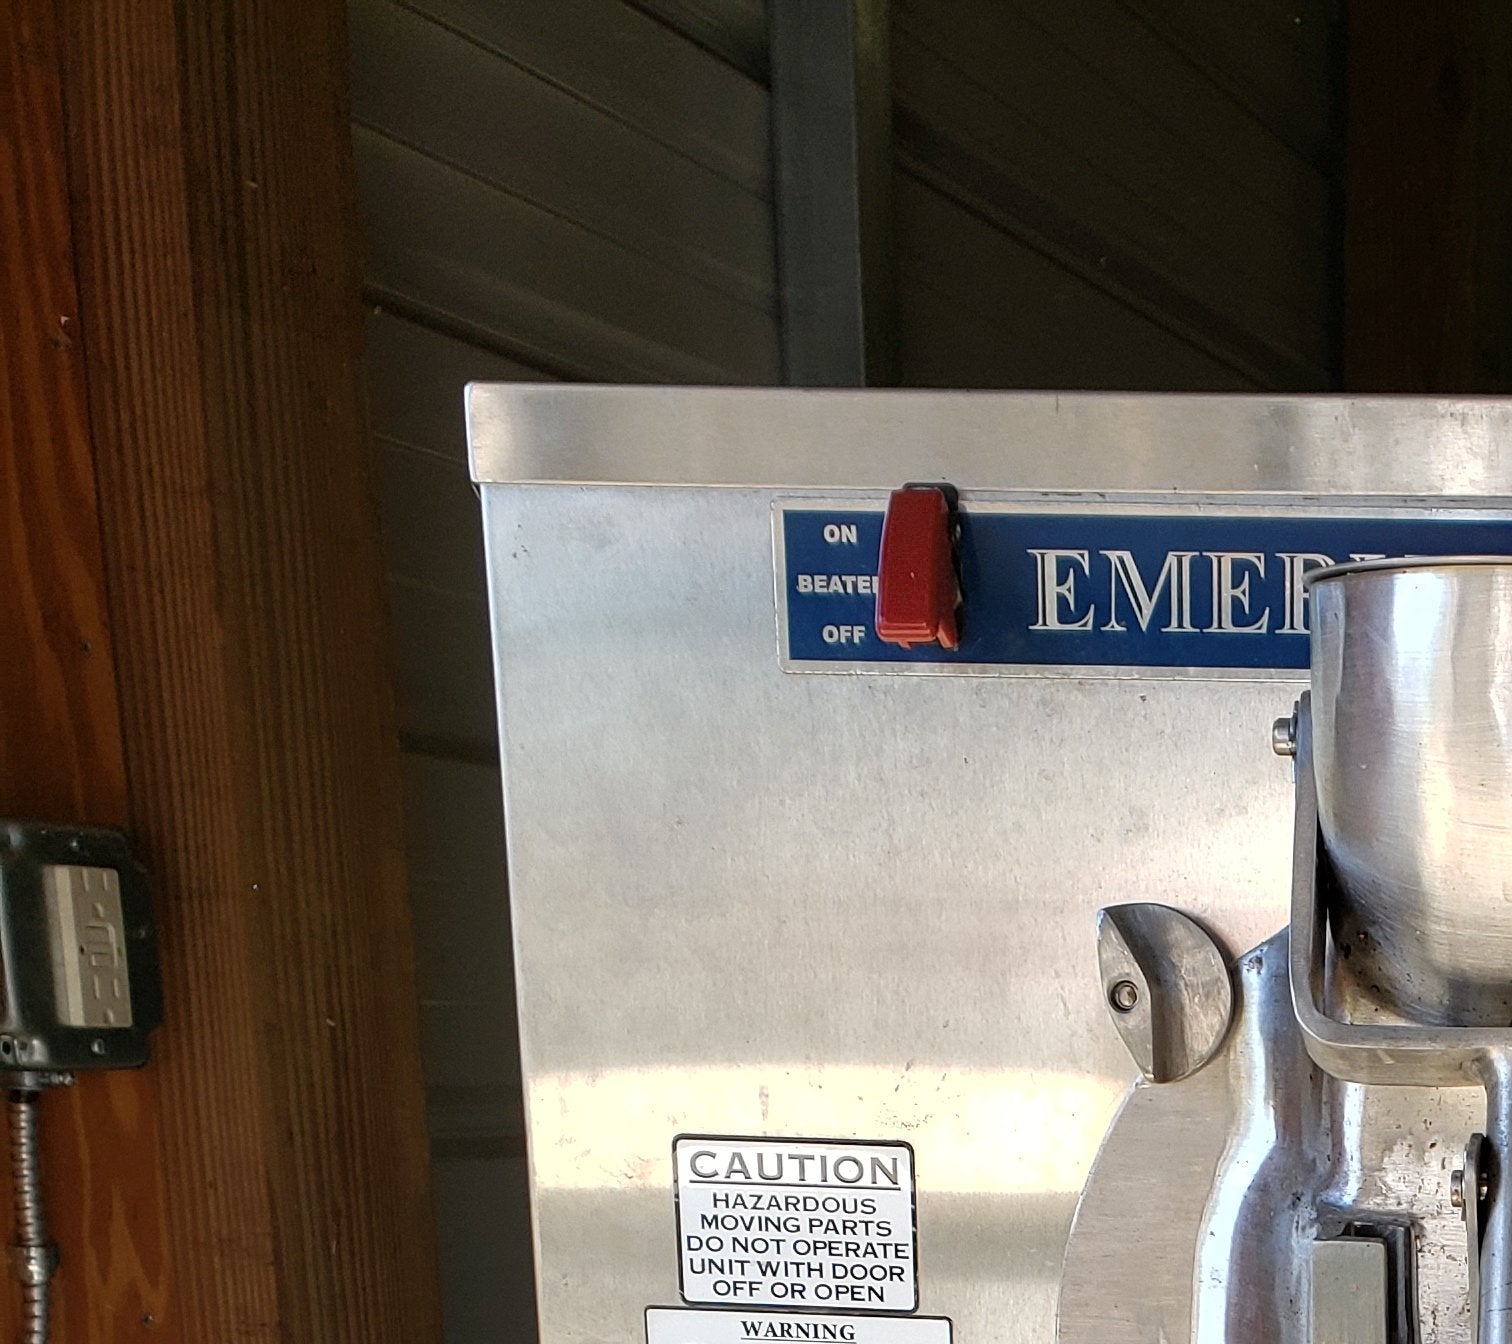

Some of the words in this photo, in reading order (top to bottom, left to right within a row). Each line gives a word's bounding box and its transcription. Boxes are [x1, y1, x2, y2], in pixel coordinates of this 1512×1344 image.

[824, 525, 857, 544] ON
[823, 625, 865, 644] OFF
[689, 1151, 899, 1186] CAUTION
[713, 1193, 876, 1214] HAZARDOUS
[701, 1214, 800, 1233] MOVING
[809, 1218, 891, 1237] PARTS
[687, 1235, 723, 1252] DO
[732, 1237, 786, 1254] NOT
[793, 1240, 909, 1259] OPERATE
[690, 1258, 750, 1275] UNIT
[757, 1261, 823, 1278] WITH
[832, 1263, 904, 1282] DOOR
[713, 1280, 762, 1297] OFF
[771, 1282, 806, 1299] OR
[815, 1284, 884, 1302] OPEN
[741, 1321, 856, 1341] WARNING
